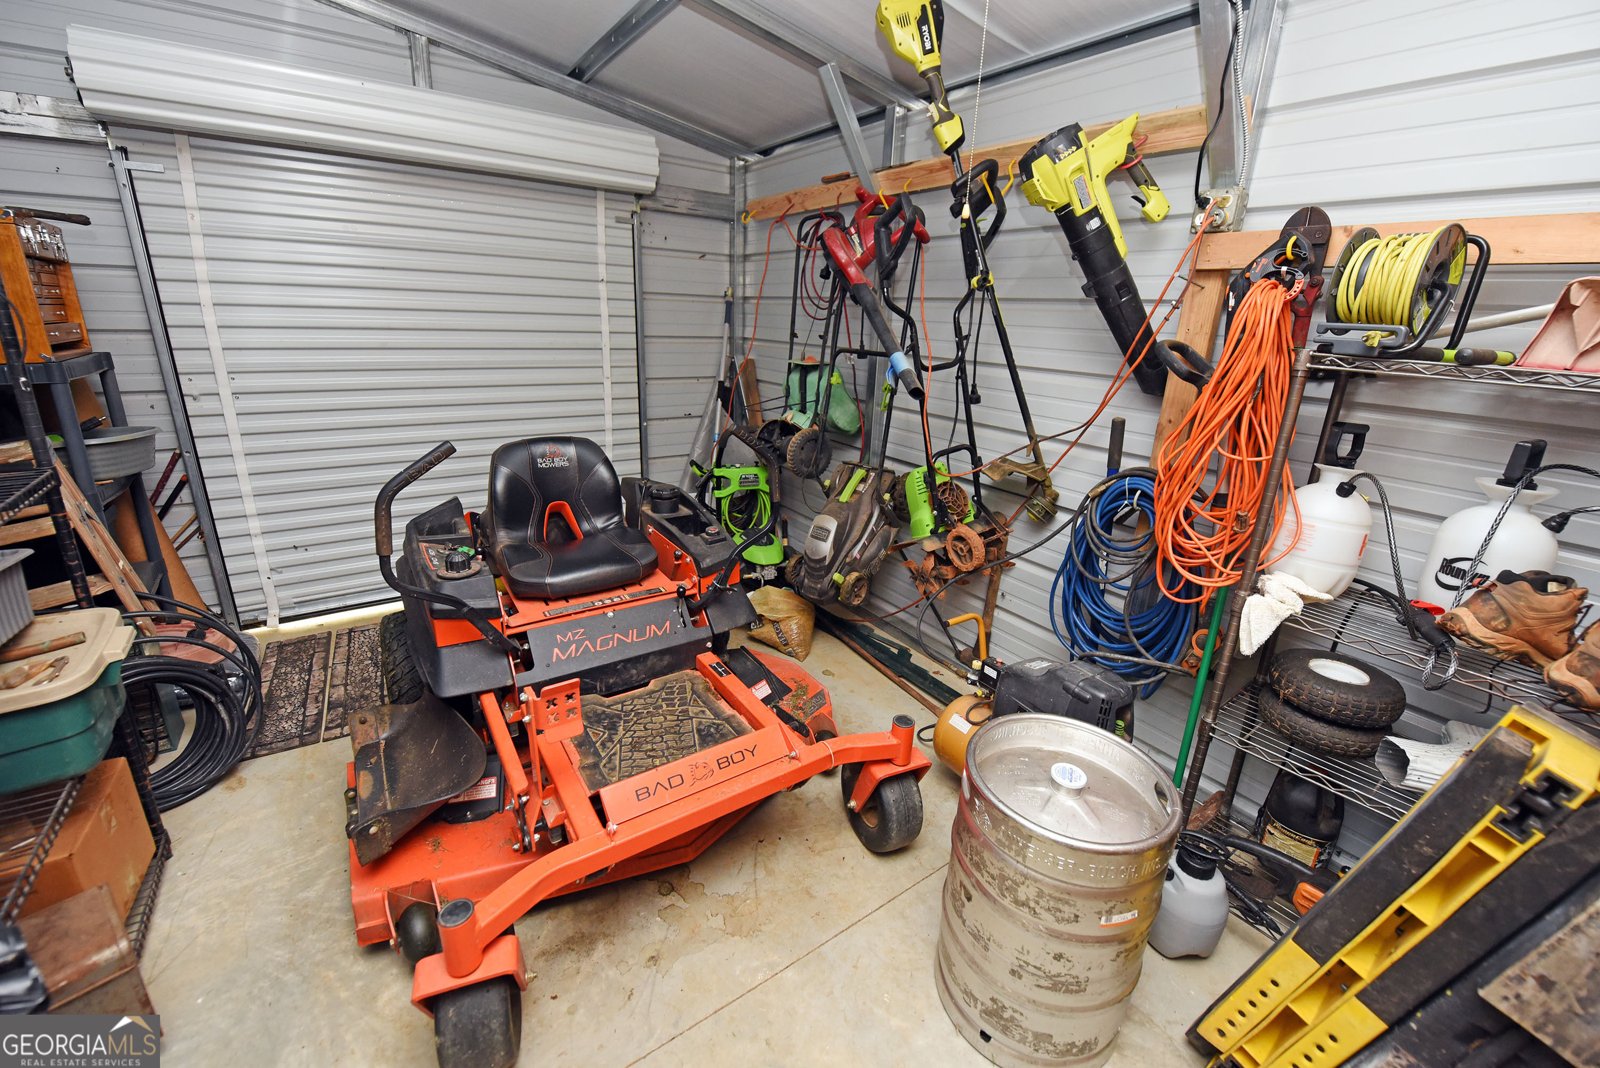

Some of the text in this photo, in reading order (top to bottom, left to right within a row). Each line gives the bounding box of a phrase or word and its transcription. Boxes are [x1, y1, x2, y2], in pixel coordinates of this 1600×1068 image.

[921, 24, 932, 50] RYOBI
[552, 619, 671, 663] MAGNUM
[556, 628, 587, 644] MZ
[634, 744, 758, 802] BAD BOY
